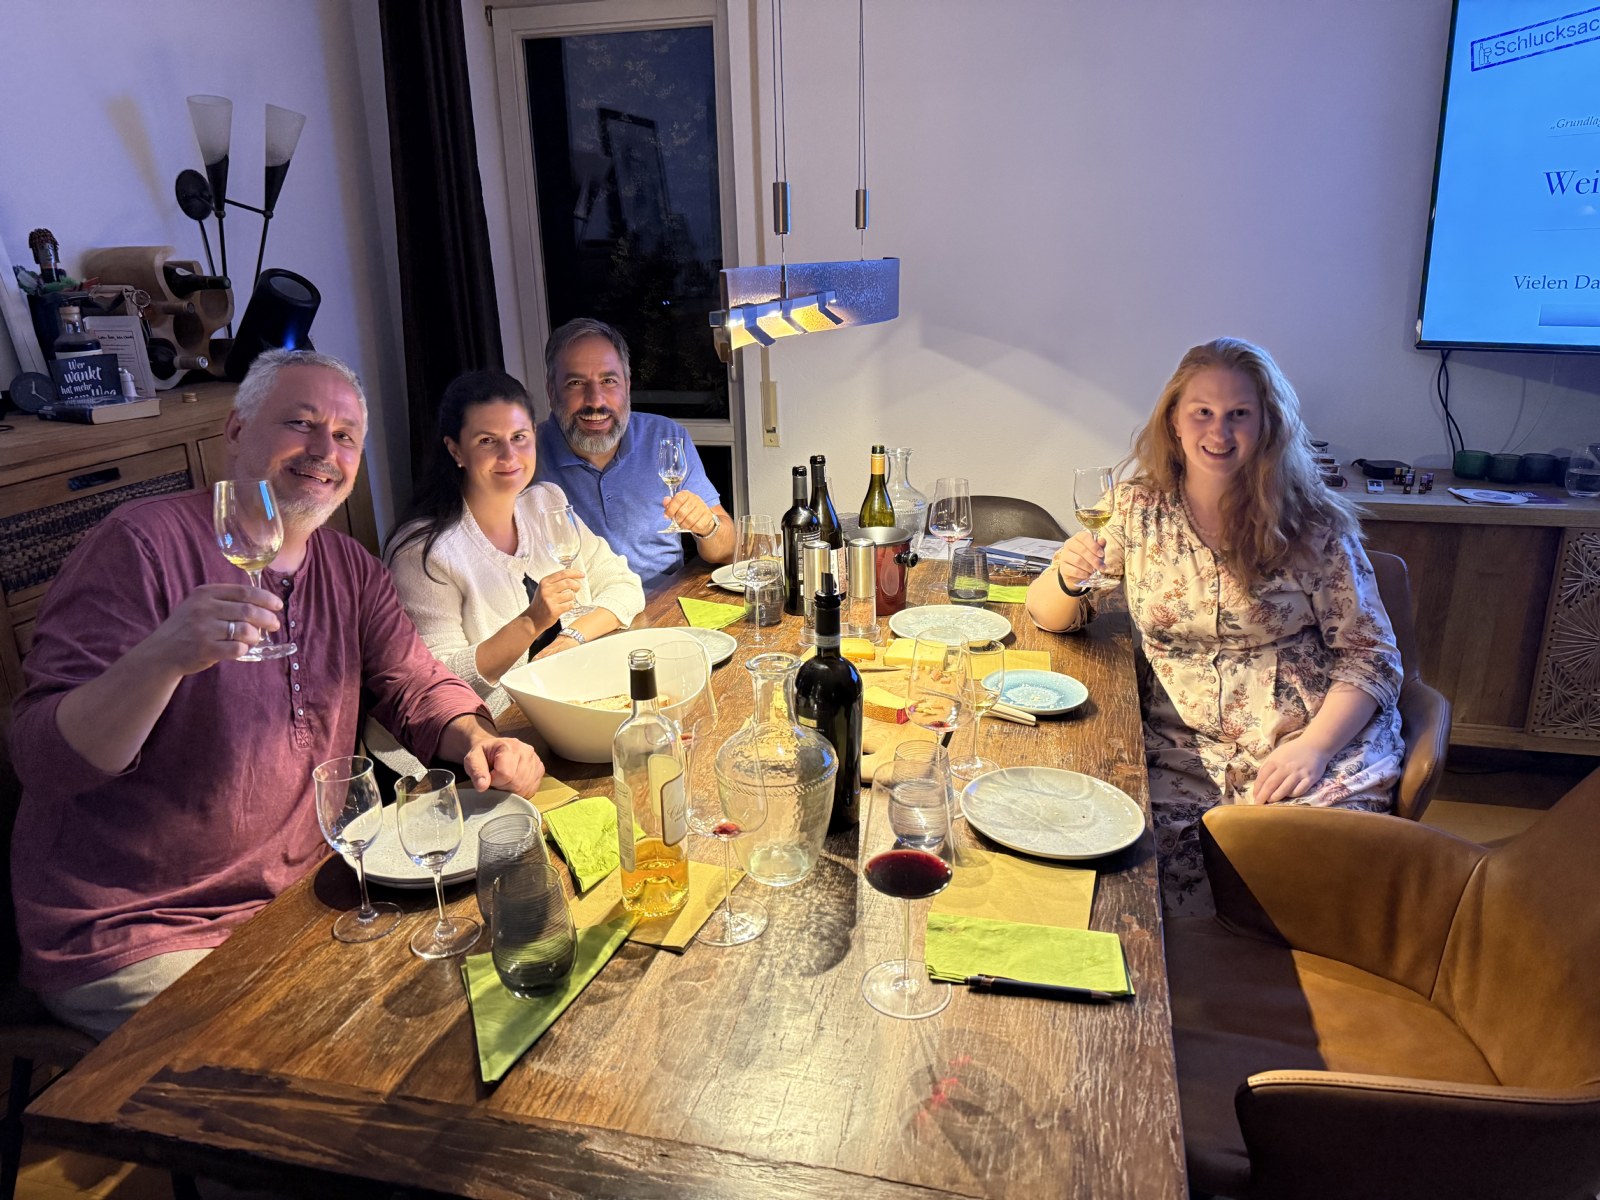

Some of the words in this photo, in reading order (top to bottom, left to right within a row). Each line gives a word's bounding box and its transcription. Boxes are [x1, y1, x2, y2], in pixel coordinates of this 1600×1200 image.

[1494, 18, 1600, 56] Schlucksac
[1543, 169, 1600, 195] Wei
[1513, 274, 1568, 290] Vielen
[1574, 274, 1600, 290] Da
[68, 359, 85, 370] Wer
[64, 366, 102, 383] wankt
[60, 384, 73, 394] hat
[73, 382, 92, 392] mehr
